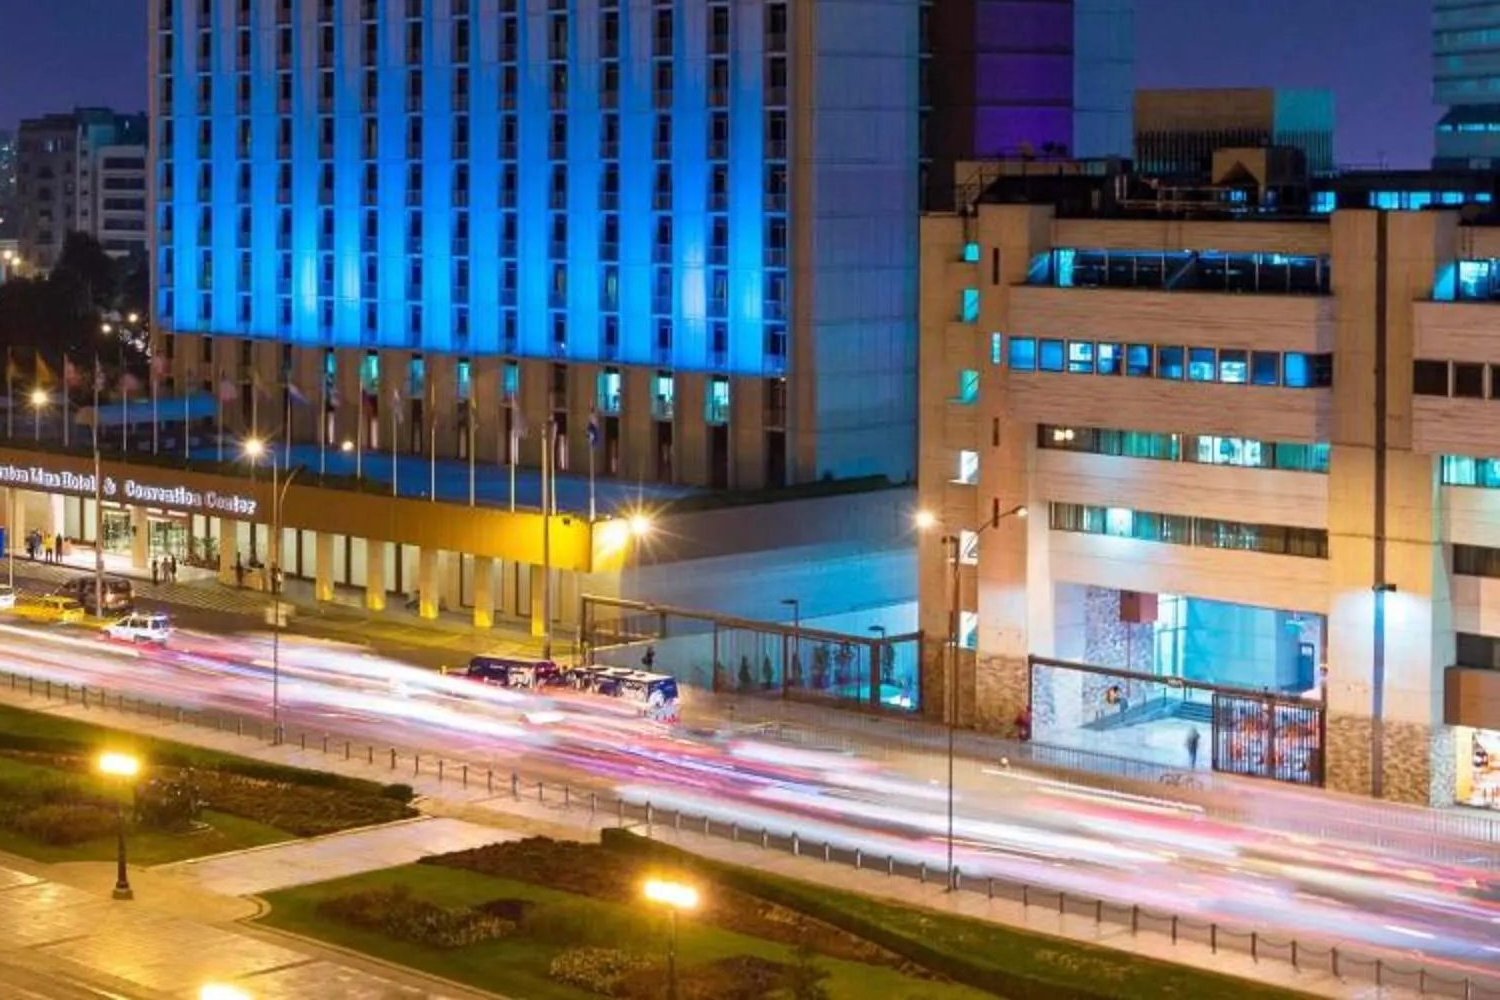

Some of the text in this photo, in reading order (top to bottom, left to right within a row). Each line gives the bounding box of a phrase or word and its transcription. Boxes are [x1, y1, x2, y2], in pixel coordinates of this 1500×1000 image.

[29, 467, 60, 486] Lima
[104, 477, 116, 495] &
[125, 480, 202, 506] Convention
[204, 491, 257, 515] Center
